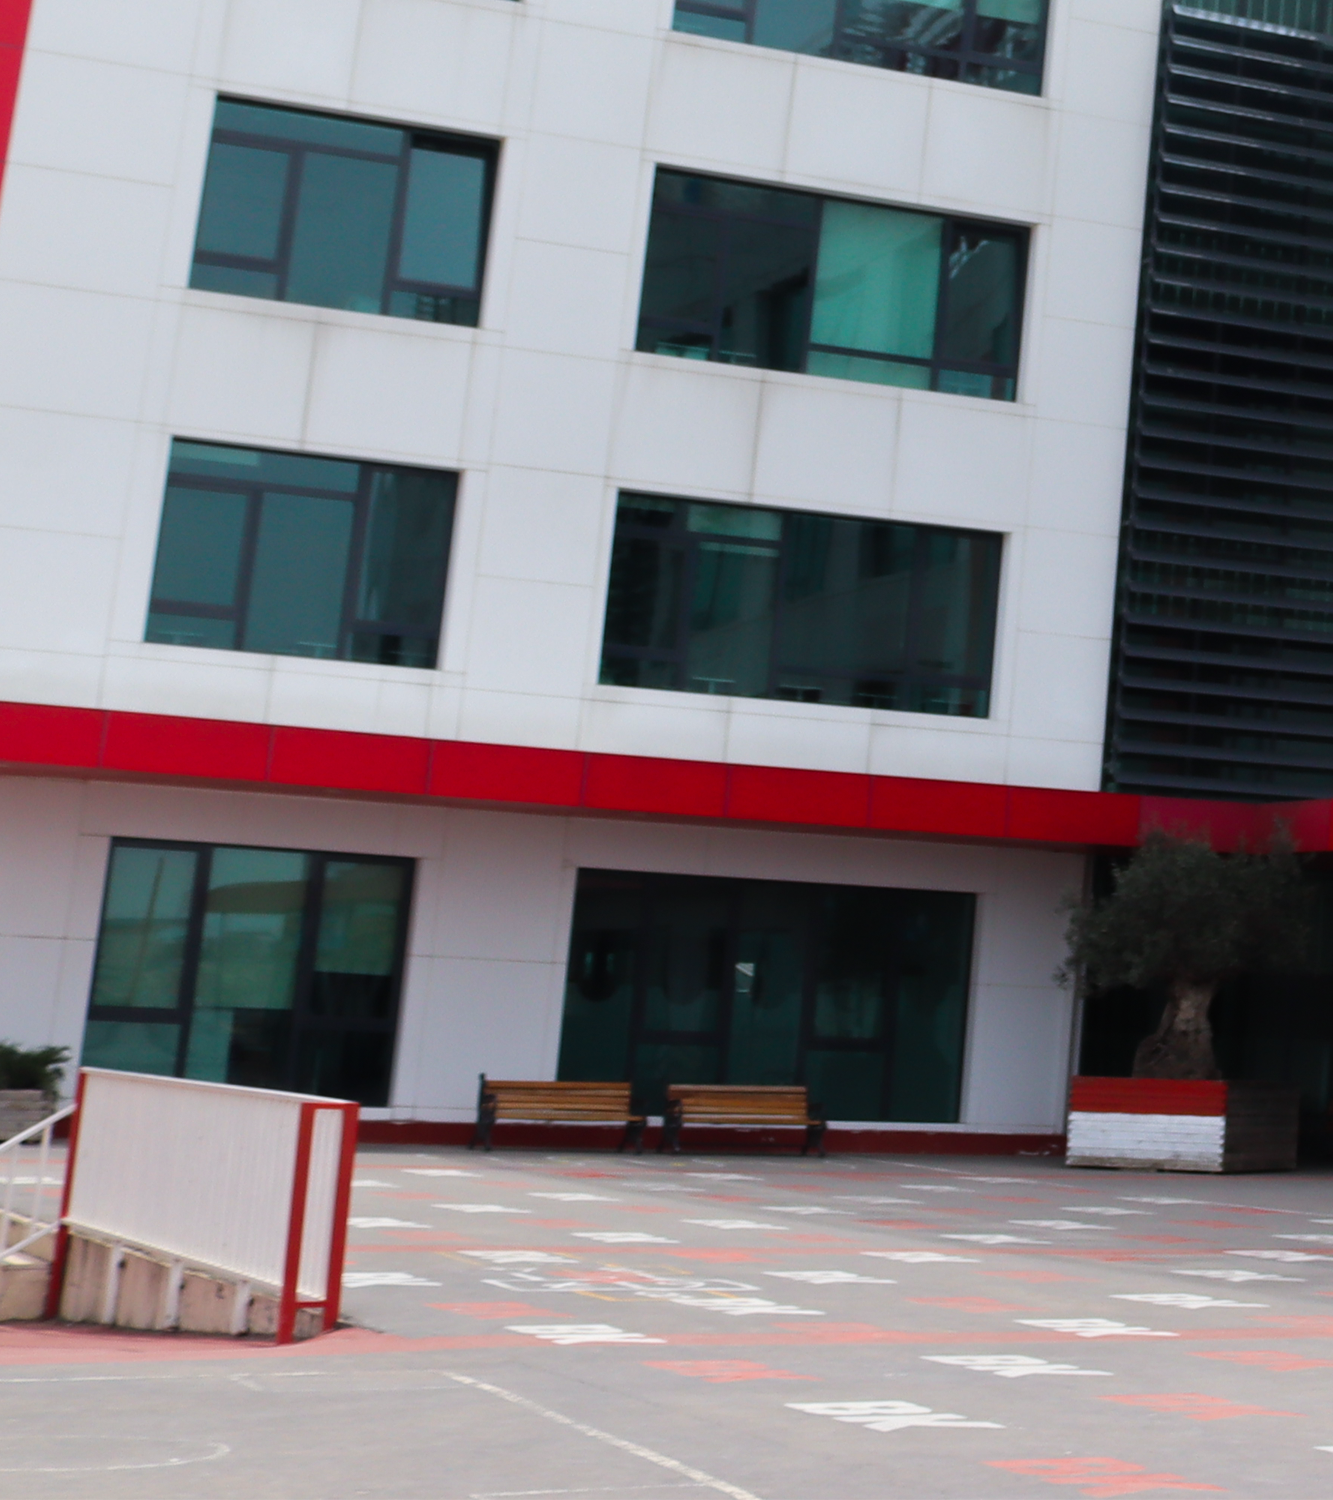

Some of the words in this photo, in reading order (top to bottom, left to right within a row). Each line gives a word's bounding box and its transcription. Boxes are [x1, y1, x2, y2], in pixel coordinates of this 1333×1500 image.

[918, 1355, 1114, 1379] BK
[783, 1400, 1006, 1432] BK
[980, 1456, 1226, 1498] BK
